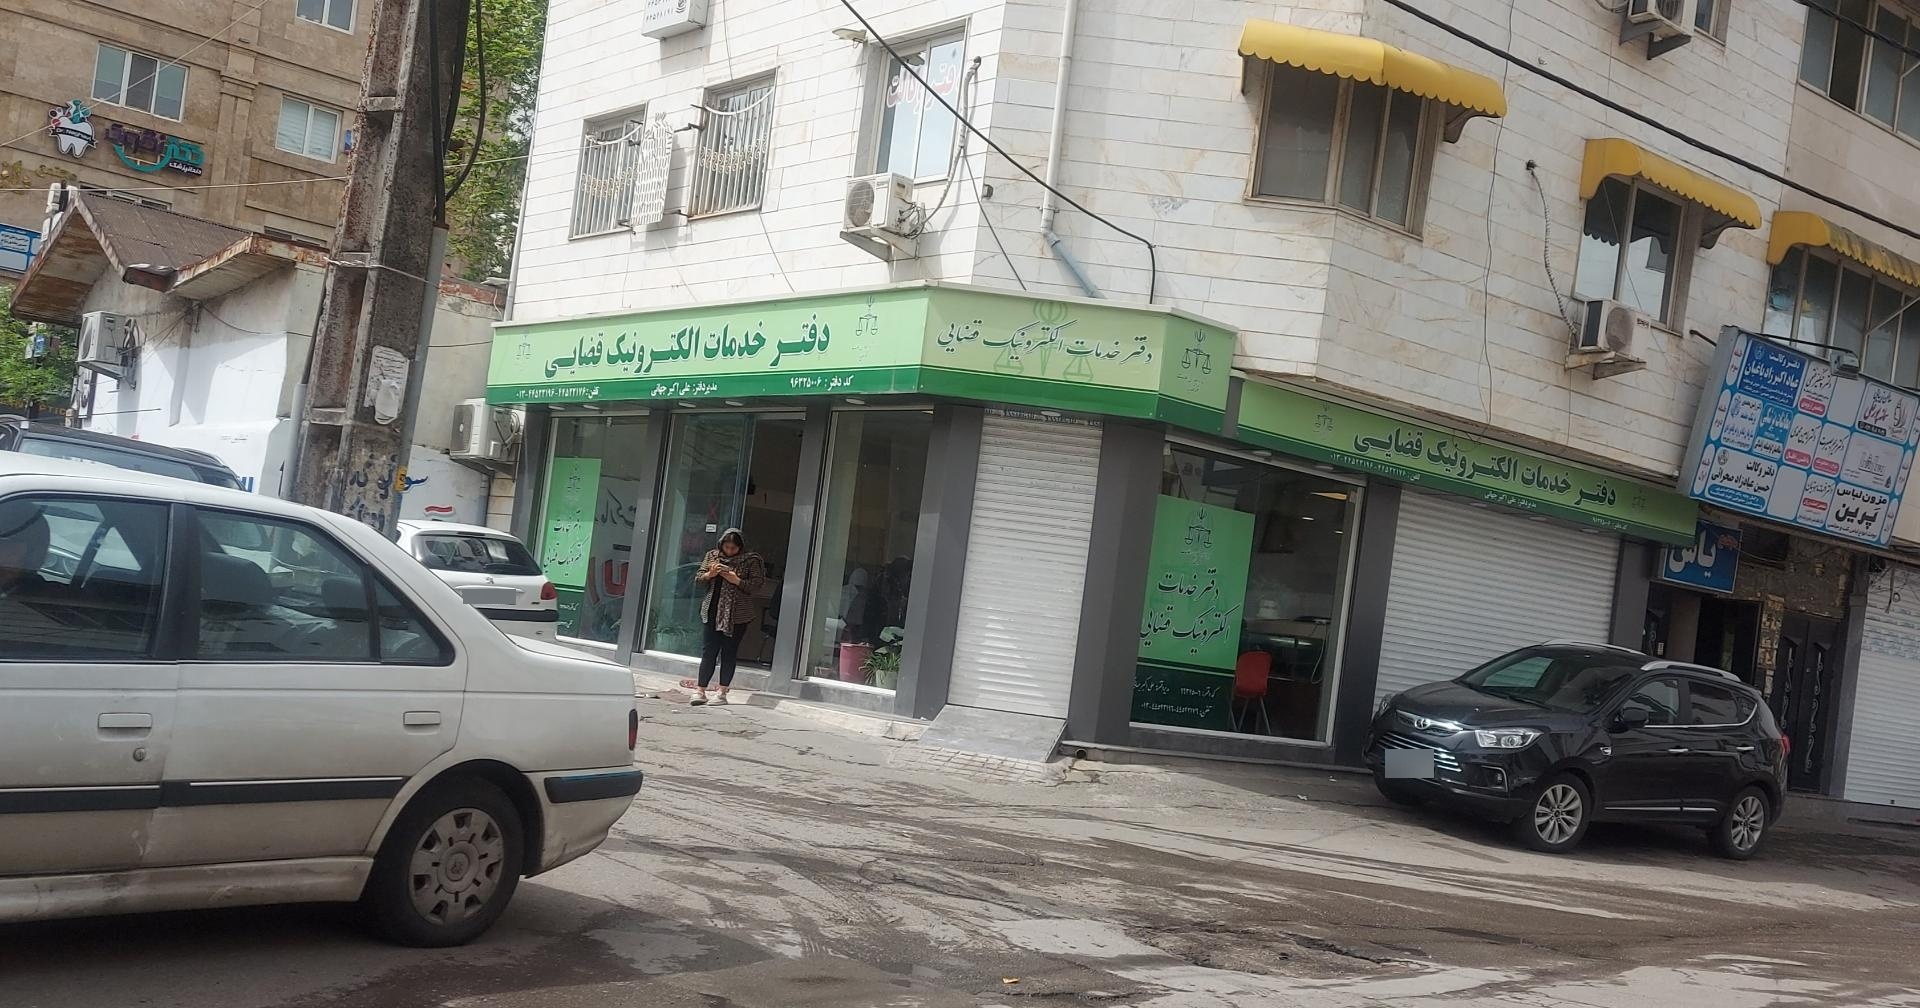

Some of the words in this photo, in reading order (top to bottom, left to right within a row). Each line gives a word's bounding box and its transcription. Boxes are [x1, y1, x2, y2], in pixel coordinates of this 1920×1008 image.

[607, 325, 701, 374] الکترونیک
[702, 321, 767, 359] خدمات
[769, 314, 830, 367] دفتر
[937, 319, 984, 353] قضایی
[983, 319, 1078, 362] الکترونیک
[1066, 340, 1121, 362] خدمات
[1123, 334, 1153, 365] دفتر
[545, 333, 604, 378] قضایی
[1353, 428, 1424, 459] قضایی
[1427, 436, 1519, 482] الکترونیک
[1520, 464, 1573, 496] خدمات
[1575, 478, 1618, 506] دفتر
[1836, 487, 1863, 501] لباس
[1862, 493, 1888, 506] مزون
[1158, 574, 1198, 595] خدمات
[1194, 568, 1219, 601] دفتر
[1172, 603, 1240, 654] الکترونیک
